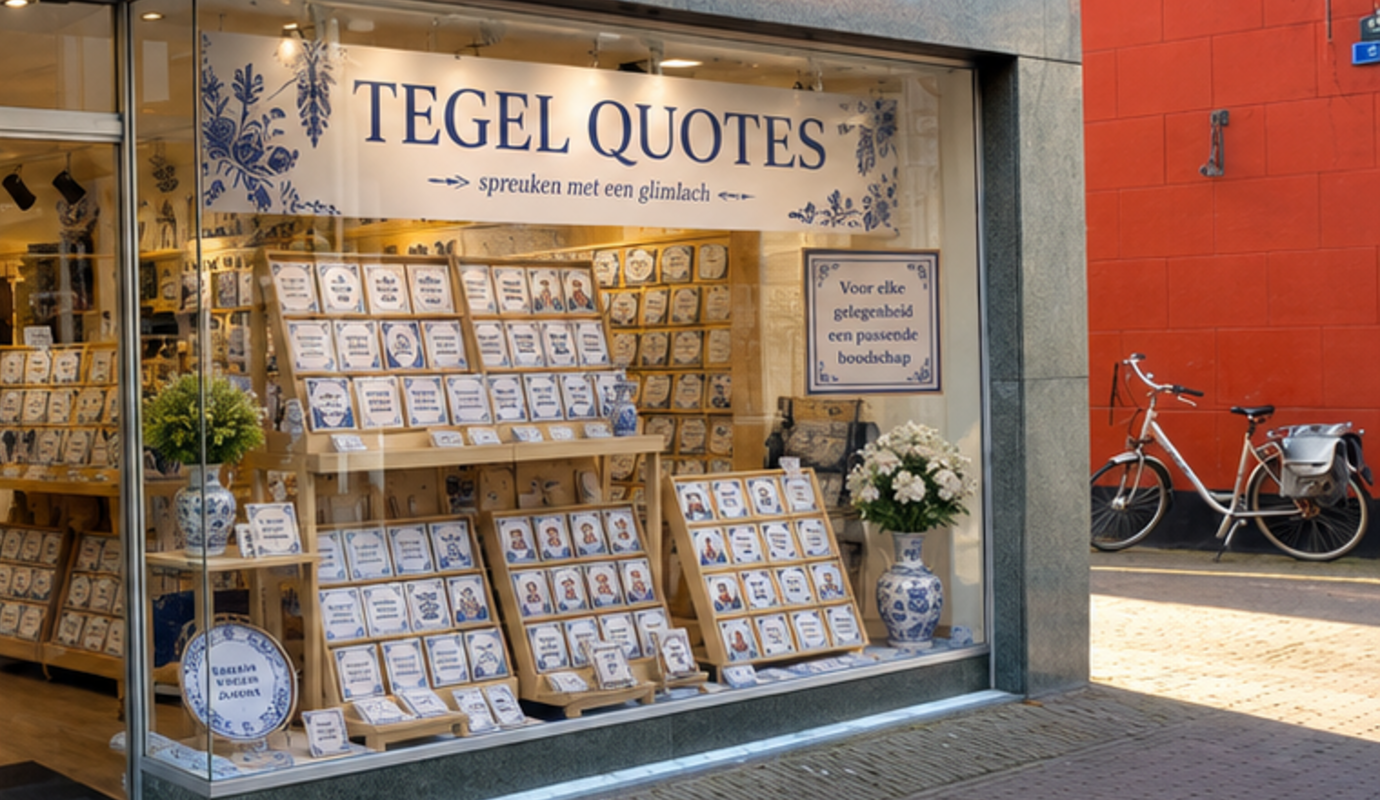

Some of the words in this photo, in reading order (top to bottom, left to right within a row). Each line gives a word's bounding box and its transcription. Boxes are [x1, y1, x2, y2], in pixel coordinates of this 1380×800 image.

[353, 80, 570, 154] TEGEL
[588, 99, 827, 170] QUOTES
[478, 173, 561, 197] spreuken
[567, 179, 600, 196] met
[604, 182, 633, 198] een
[637, 179, 710, 204] glimlach
[839, 280, 874, 295] Voor
[877, 279, 906, 295] elke
[833, 304, 914, 322] gelegenheid
[827, 330, 853, 342] een
[856, 327, 919, 346] passende
[837, 350, 912, 367] boodschap
